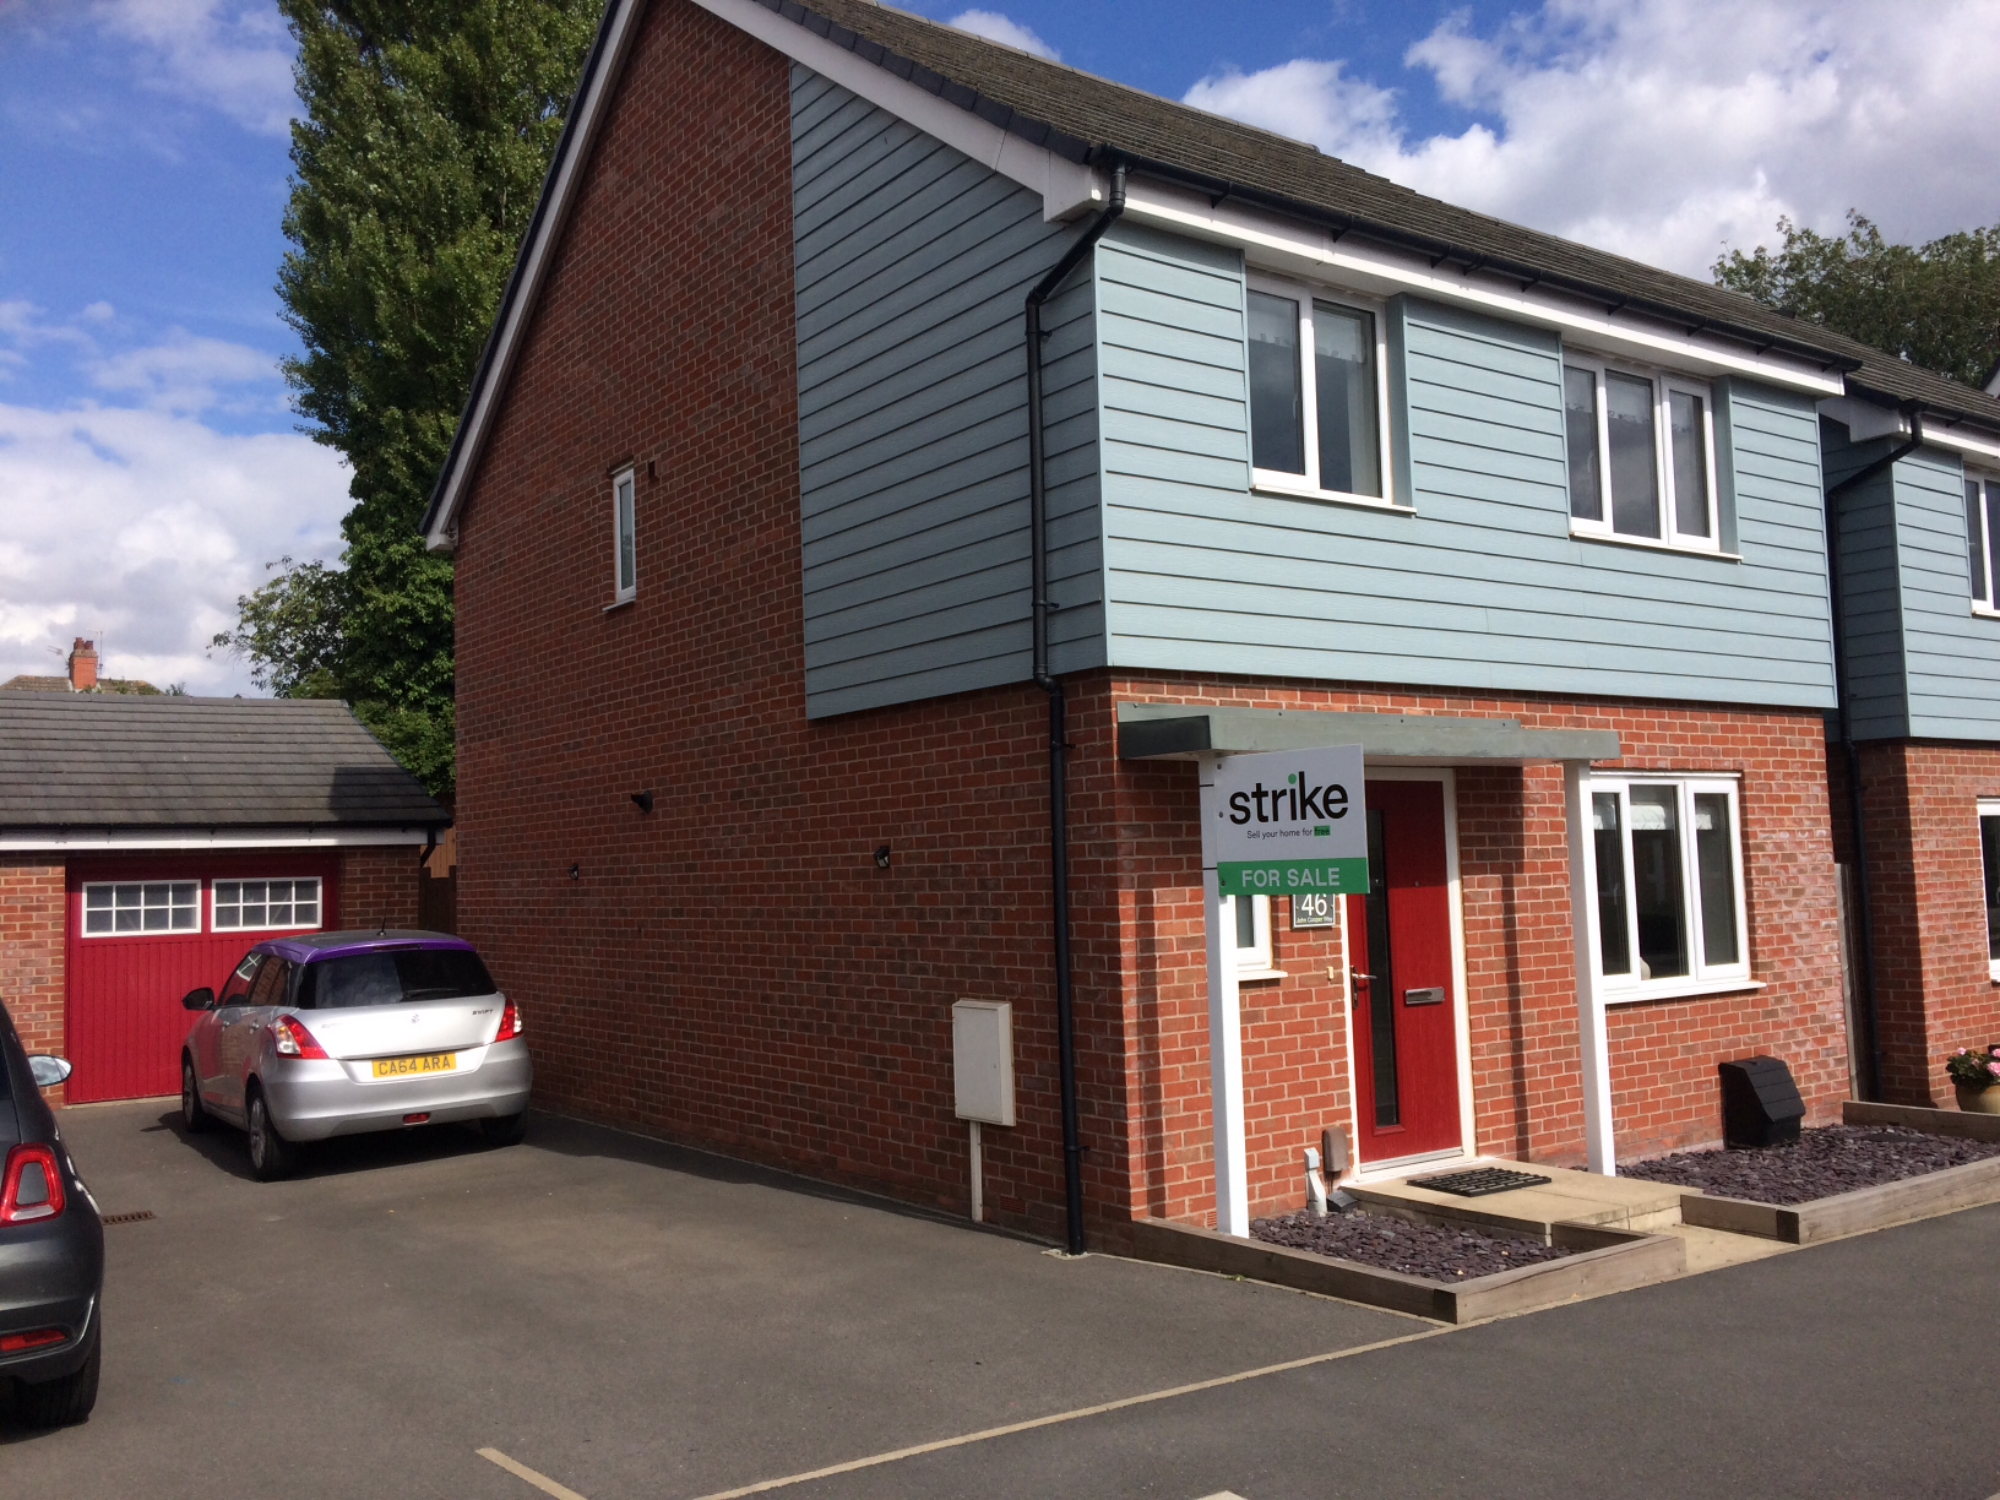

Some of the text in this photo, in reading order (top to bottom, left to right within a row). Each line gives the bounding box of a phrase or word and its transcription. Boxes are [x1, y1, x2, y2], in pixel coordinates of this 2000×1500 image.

[1229, 771, 1349, 825] strike
[1247, 826, 1330, 840] Sell your home for free
[1242, 868, 1340, 888] FOR SALE
[1301, 893, 1327, 916] 46
[379, 1056, 450, 1075] CA64 ARA
